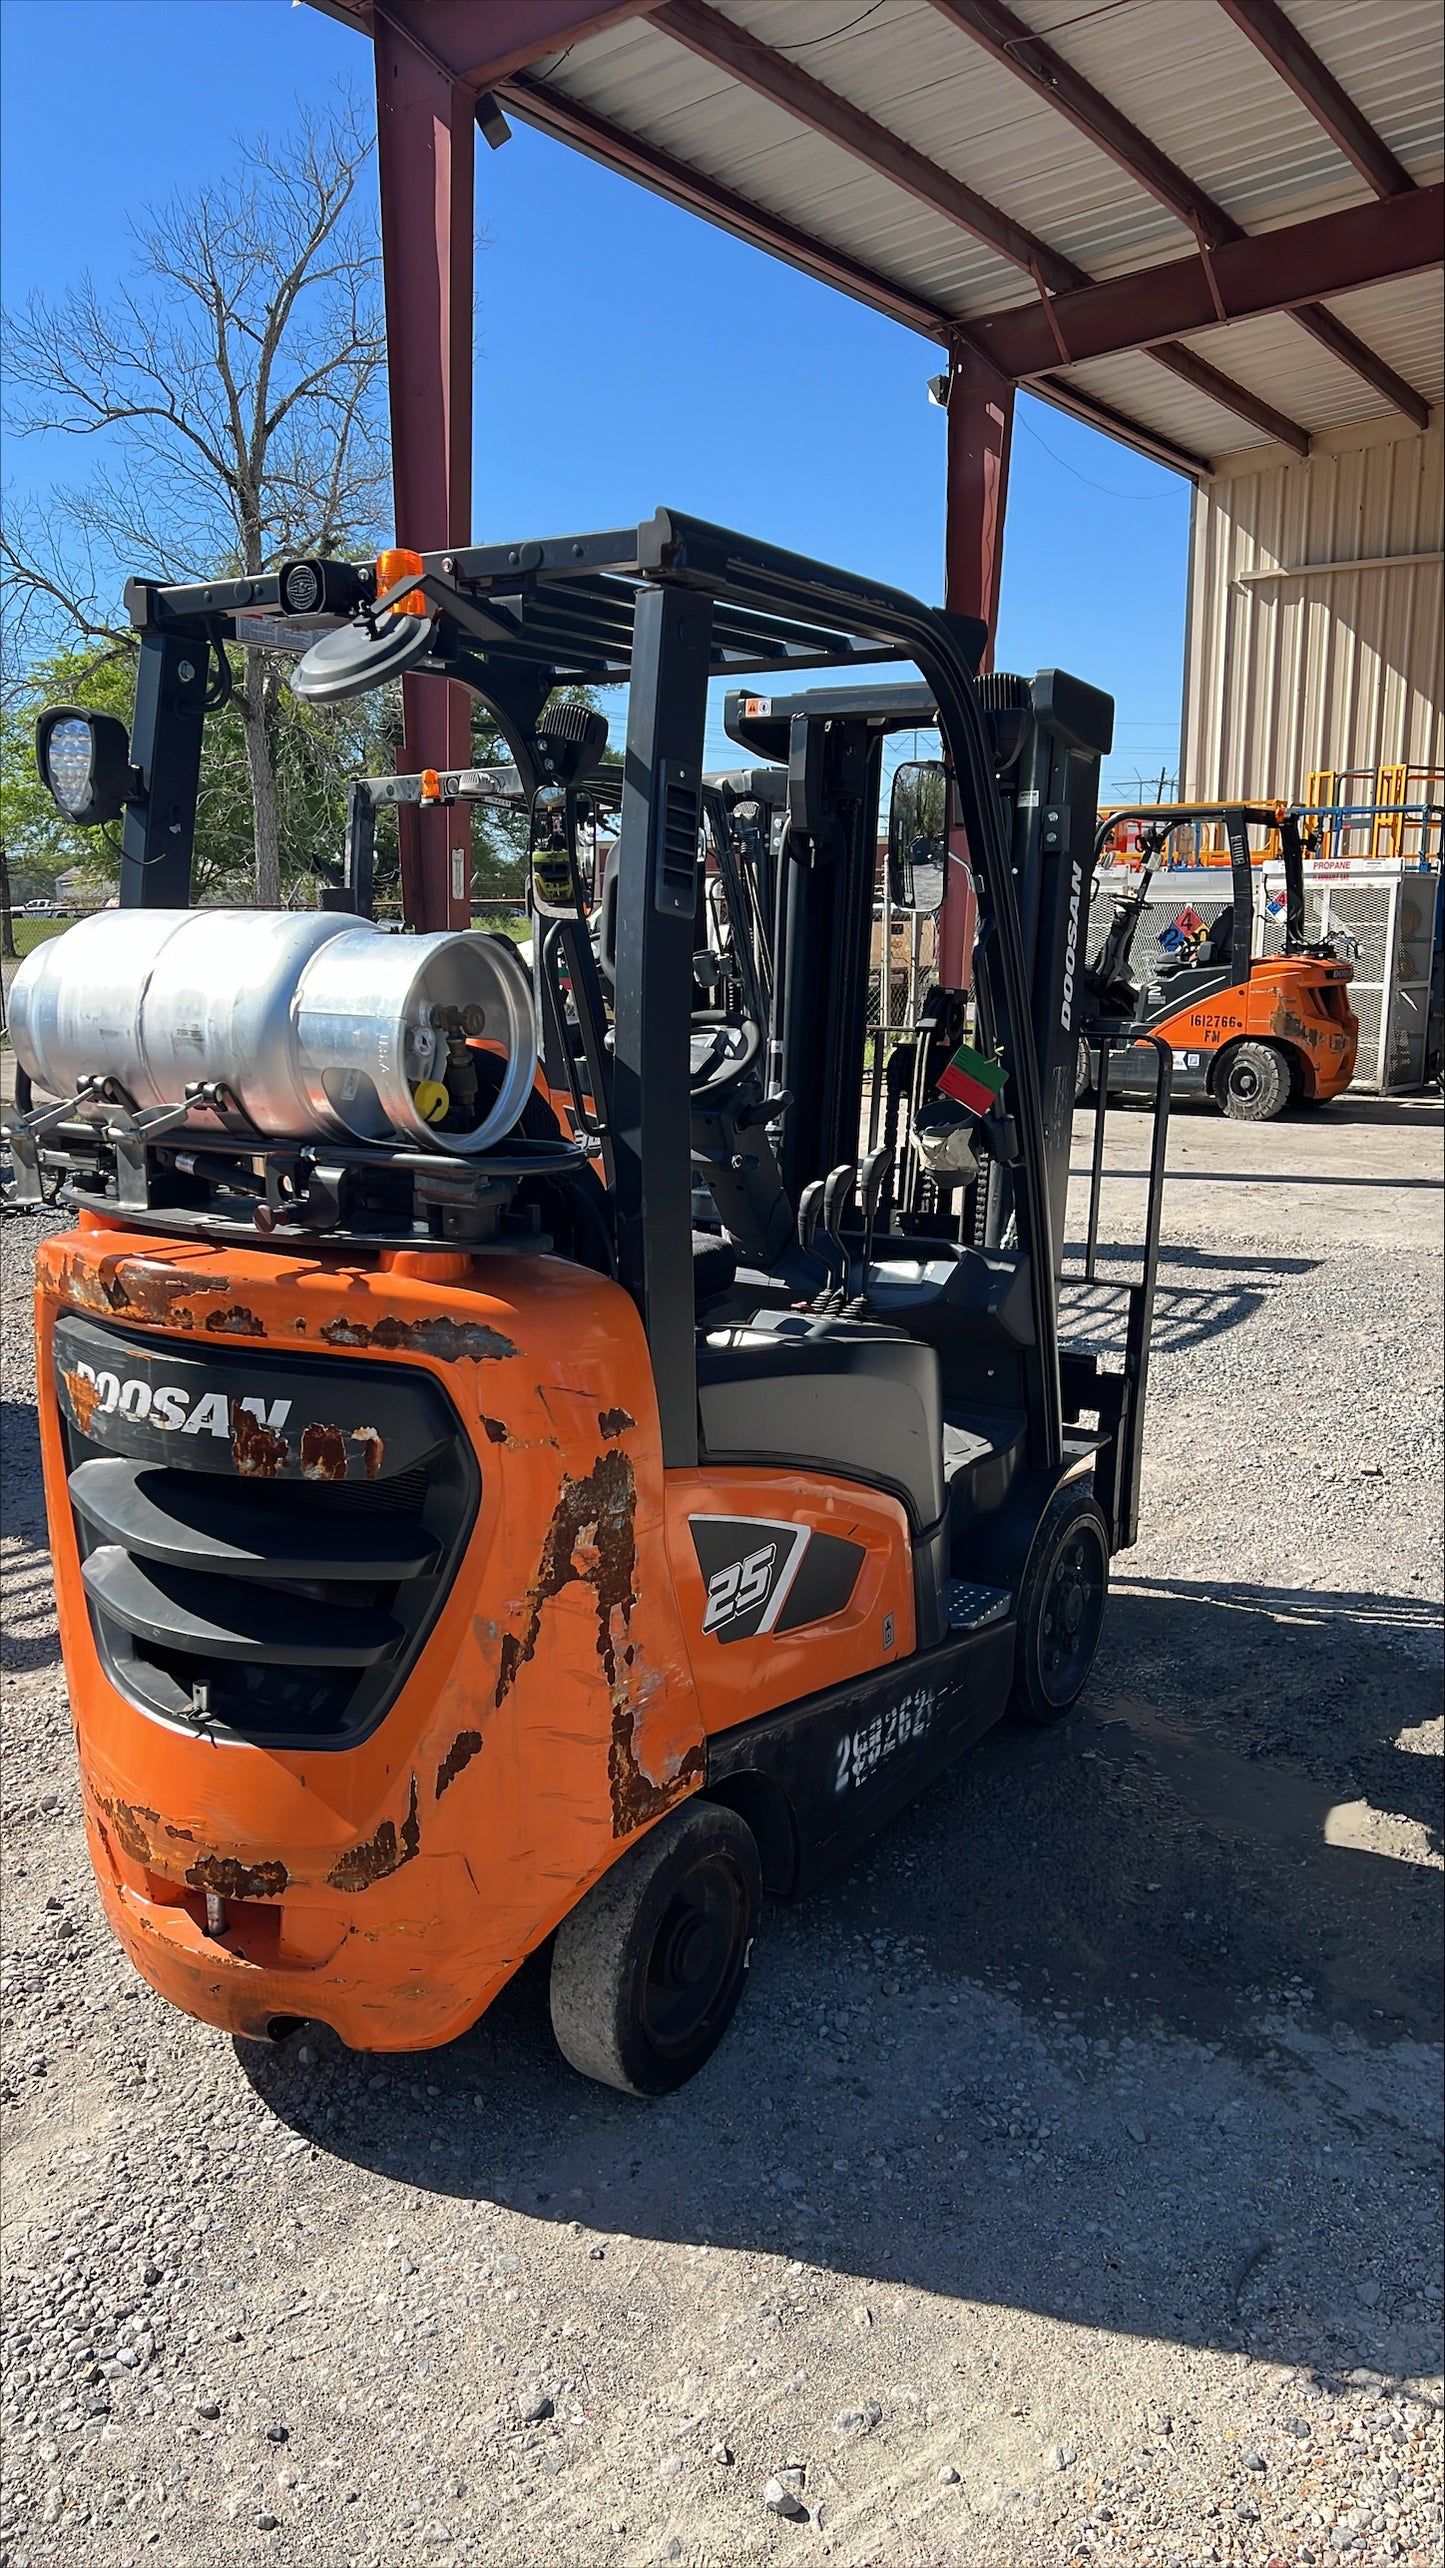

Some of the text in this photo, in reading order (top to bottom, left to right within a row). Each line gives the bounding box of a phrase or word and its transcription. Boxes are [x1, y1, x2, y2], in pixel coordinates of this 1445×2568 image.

[1313, 861, 1351, 870] PROPANE
[1180, 912, 1193, 931] 4
[1060, 860, 1083, 1032] DOOSAN
[1190, 1014, 1236, 1028] 1612766
[702, 1543, 777, 1636] 25
